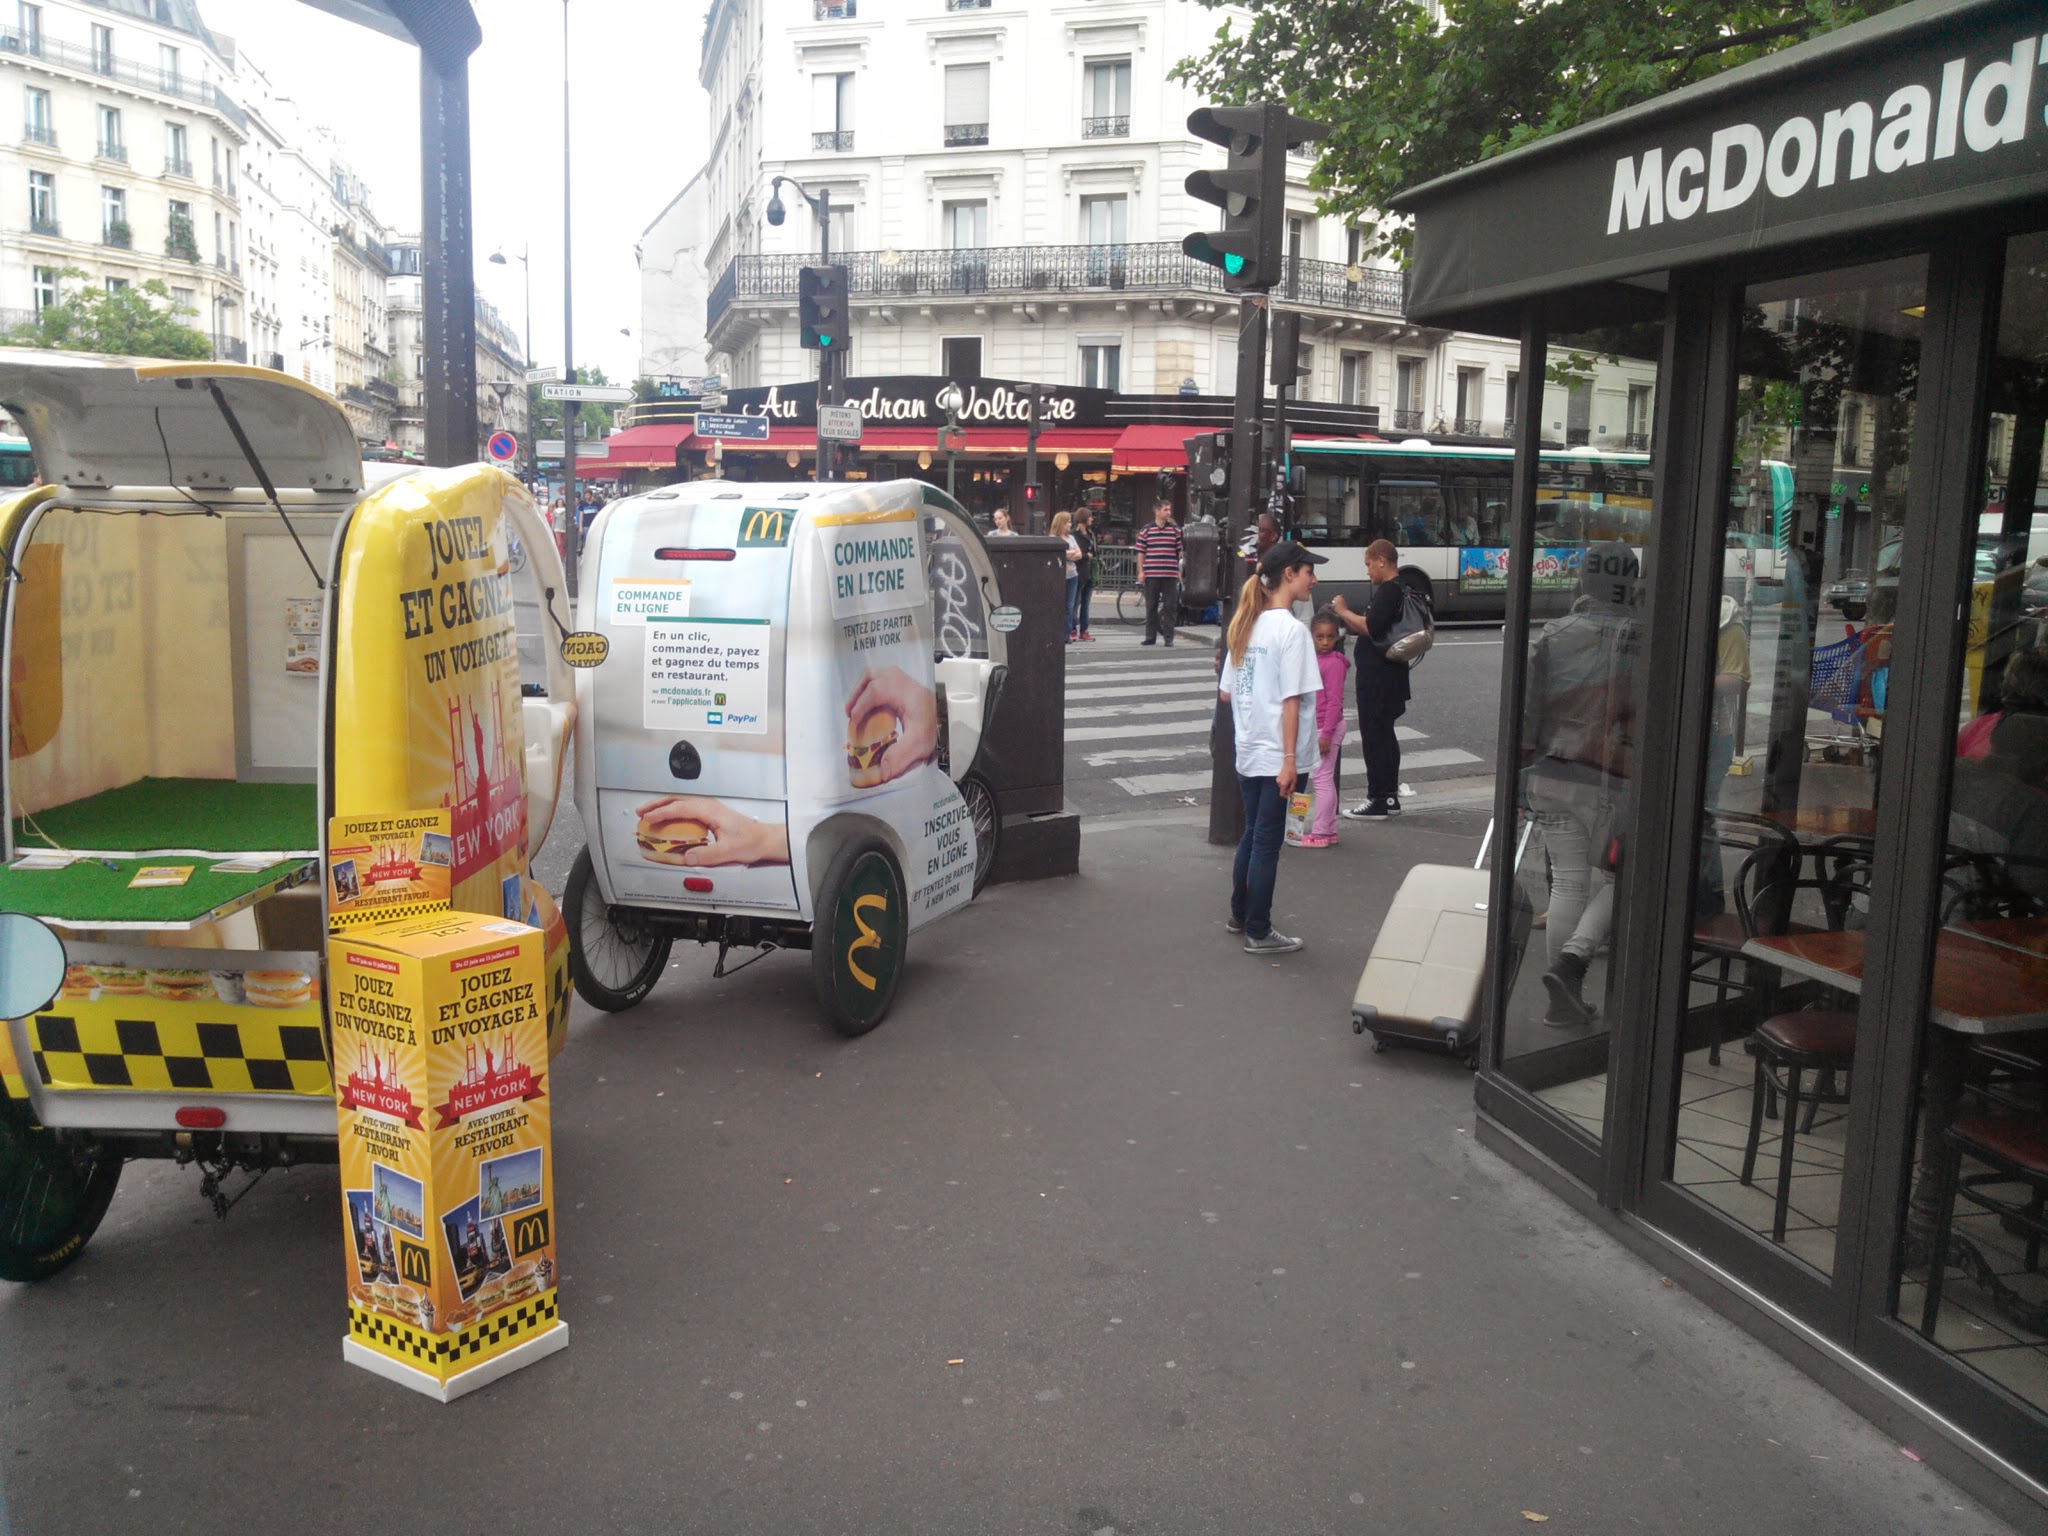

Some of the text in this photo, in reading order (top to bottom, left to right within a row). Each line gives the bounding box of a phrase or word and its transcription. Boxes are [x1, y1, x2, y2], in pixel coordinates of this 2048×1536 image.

[1607, 33, 2048, 236] McDonald
[547, 388, 582, 396] NATION
[742, 386, 798, 419] Au
[818, 386, 927, 420] dran
[828, 420, 854, 428] ATTENTION
[830, 409, 852, 418] PIÉTONS
[837, 427, 859, 436] DÉCALÉS
[424, 516, 488, 580] JOUEZ
[834, 537, 915, 566] COMMANDE
[837, 568, 905, 599] EN LIGNE
[618, 590, 682, 601] COMMANDE
[400, 589, 434, 640] ET
[617, 603, 670, 614] EN LIGNE
[653, 631, 666, 640] En
[688, 632, 710, 642] clic,
[844, 615, 913, 639] TENTEZ DE PARTIR
[652, 645, 759, 657] commandez, payez
[860, 635, 877, 650] NEW
[879, 632, 901, 646] YORK
[424, 650, 446, 684] UN
[450, 636, 501, 675] VOYAGE
[652, 658, 759, 670] et gagnez du temps
[668, 671, 728, 681] restaurant.
[661, 687, 711, 696] mcdonalds.fr
[668, 697, 711, 706] l'application
[727, 714, 757, 723] PayPal
[344, 817, 439, 837] JOUEZ ET GAGNEZ
[370, 834, 379, 842] UN
[381, 832, 408, 841] VOYAGE
[451, 802, 520, 868] NEW YORK
[937, 828, 960, 851] VOUS
[928, 842, 968, 876] EN LIGNE
[373, 870, 389, 878] NEW
[914, 862, 974, 902] ET TENTEZ DE PARTIR
[355, 891, 430, 907] RESTAURANT FAVORI
[931, 894, 944, 906] NEW
[946, 883, 960, 898] YORK
[354, 974, 394, 998] JOUEZ
[461, 967, 512, 999] JOUEZ
[340, 992, 412, 1023] ET GAGNEZ
[439, 983, 534, 1022] ET GAGNEZ
[336, 1011, 417, 1046] UN VOYAGE À
[432, 1000, 539, 1045] UN VOYAGE À
[352, 1088, 409, 1115] NEW YORK
[454, 1079, 527, 1111] NEW YORK
[362, 1115, 400, 1133] AVEC VOTRE
[468, 1107, 516, 1130] AVEC VOTRE
[353, 1124, 410, 1151] RESTAURANT
[454, 1114, 529, 1148] RESTAURANT
[366, 1143, 399, 1162] FAVORI
[472, 1134, 514, 1157] FAVORI
